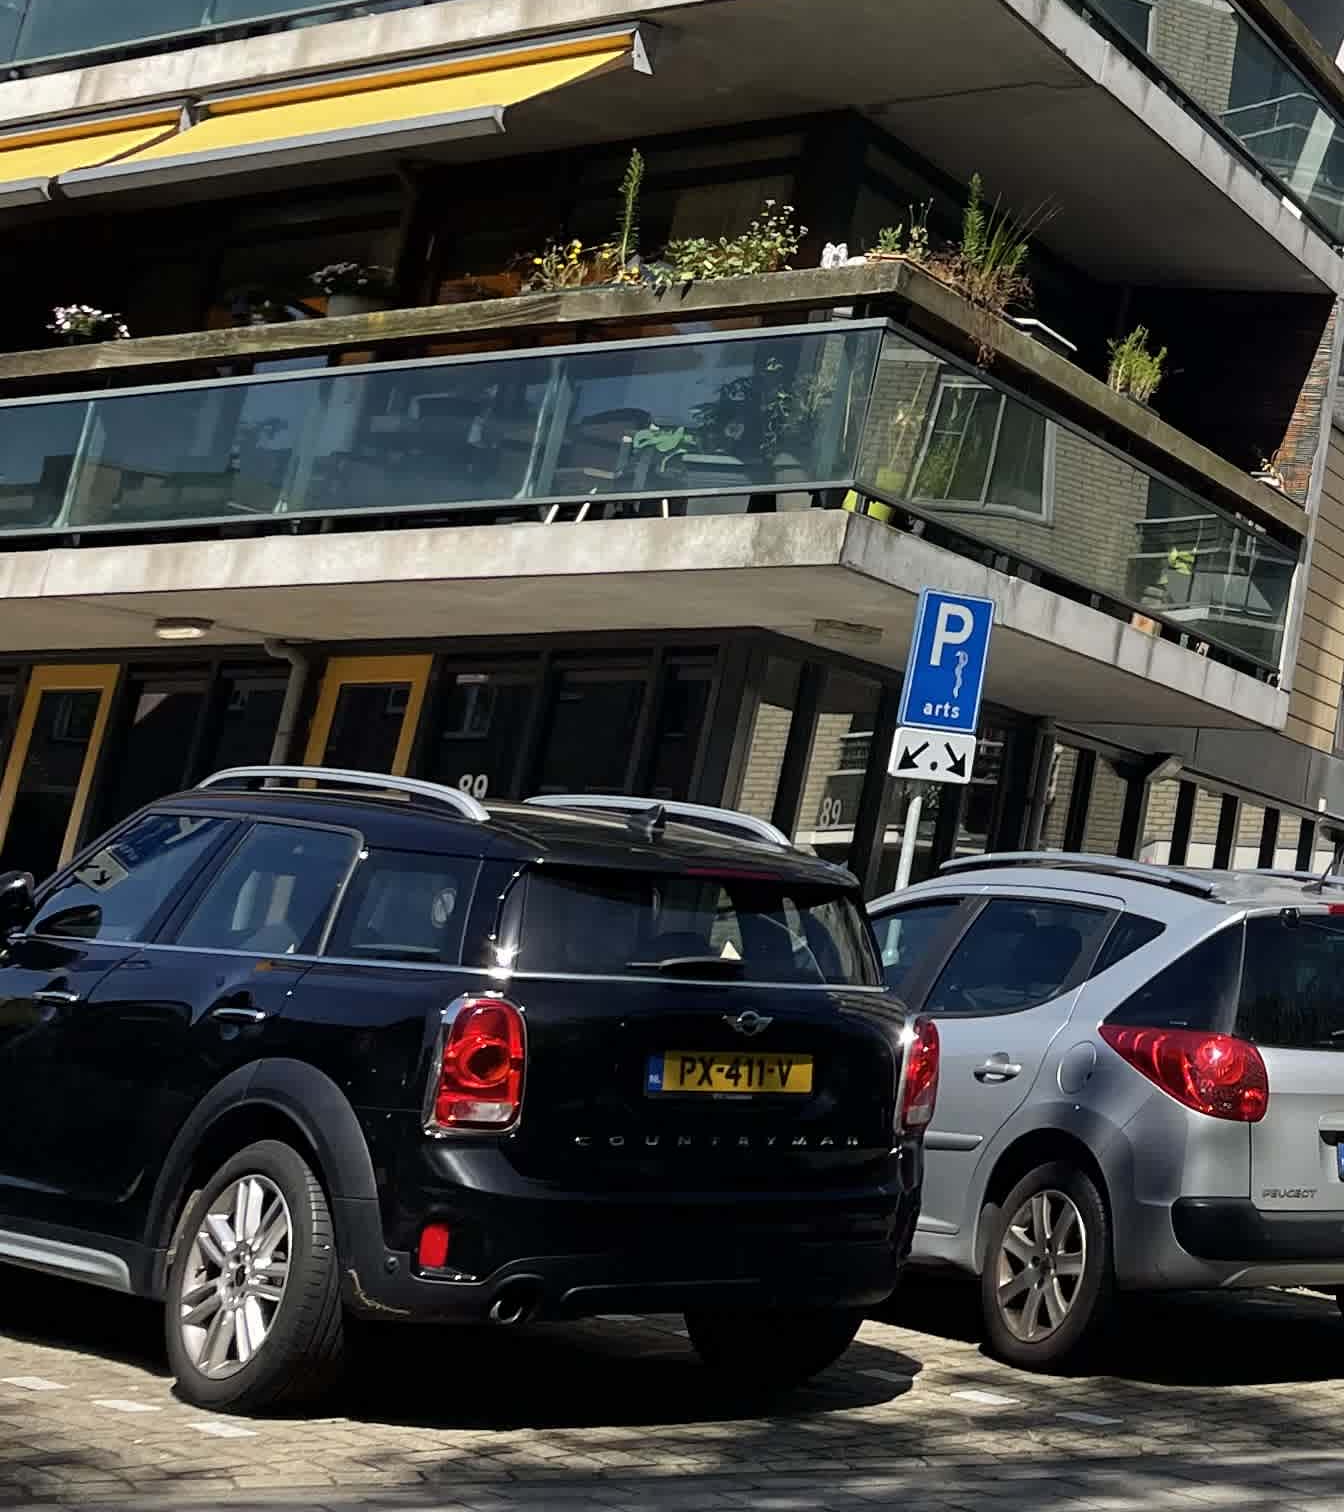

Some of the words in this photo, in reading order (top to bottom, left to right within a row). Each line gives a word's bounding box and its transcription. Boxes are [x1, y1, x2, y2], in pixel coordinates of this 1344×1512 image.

[930, 602, 974, 667] P
[923, 700, 961, 719] arts
[820, 798, 842, 825] 89
[680, 1055, 793, 1087] PX-411-V
